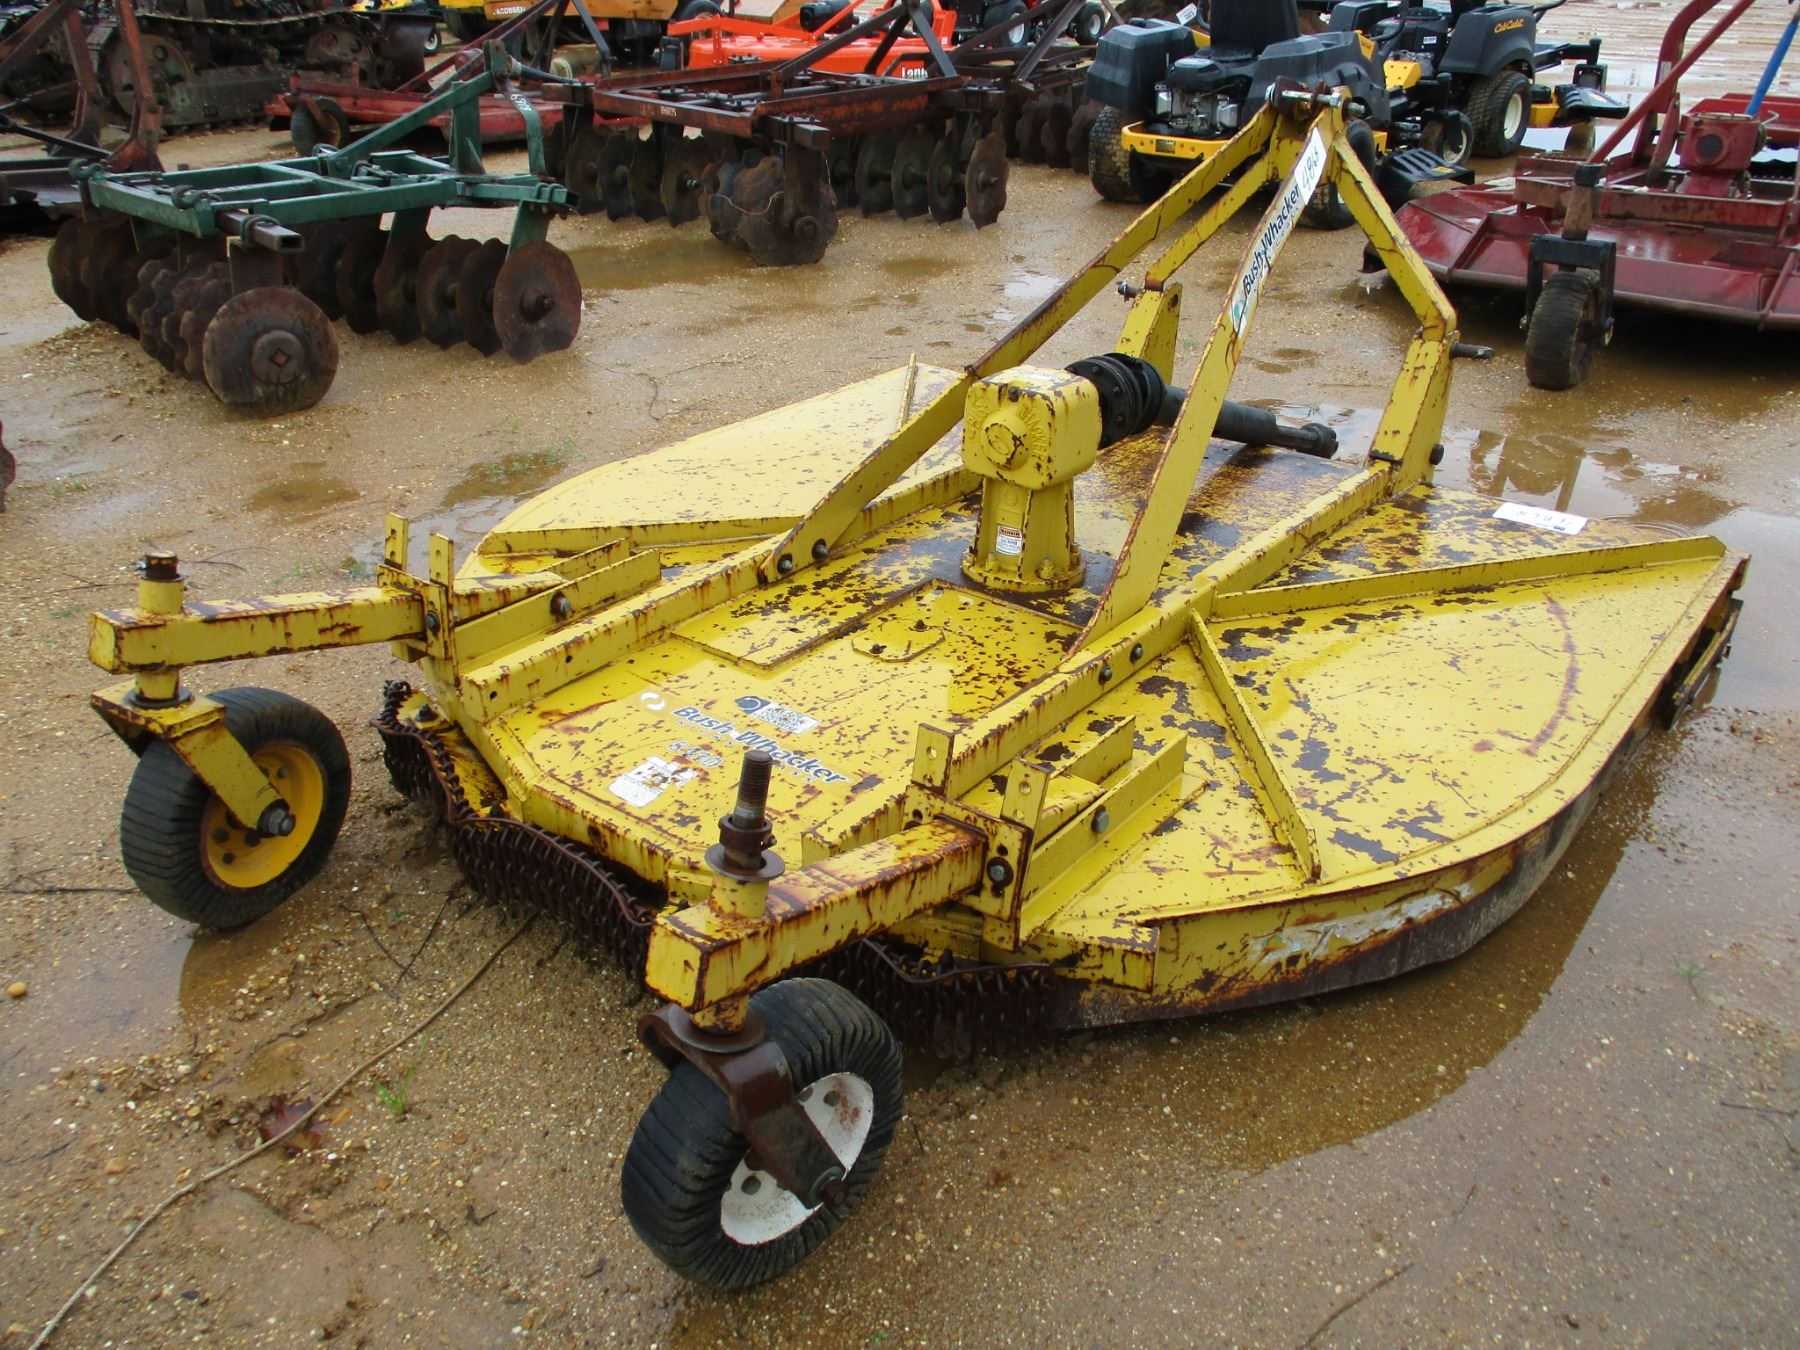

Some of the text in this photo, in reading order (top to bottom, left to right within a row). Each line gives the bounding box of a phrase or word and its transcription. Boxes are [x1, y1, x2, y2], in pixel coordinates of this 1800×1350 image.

[1262, 183, 1300, 252] Whacker
[672, 706, 736, 735] Bush
[735, 730, 848, 783] Whacker
